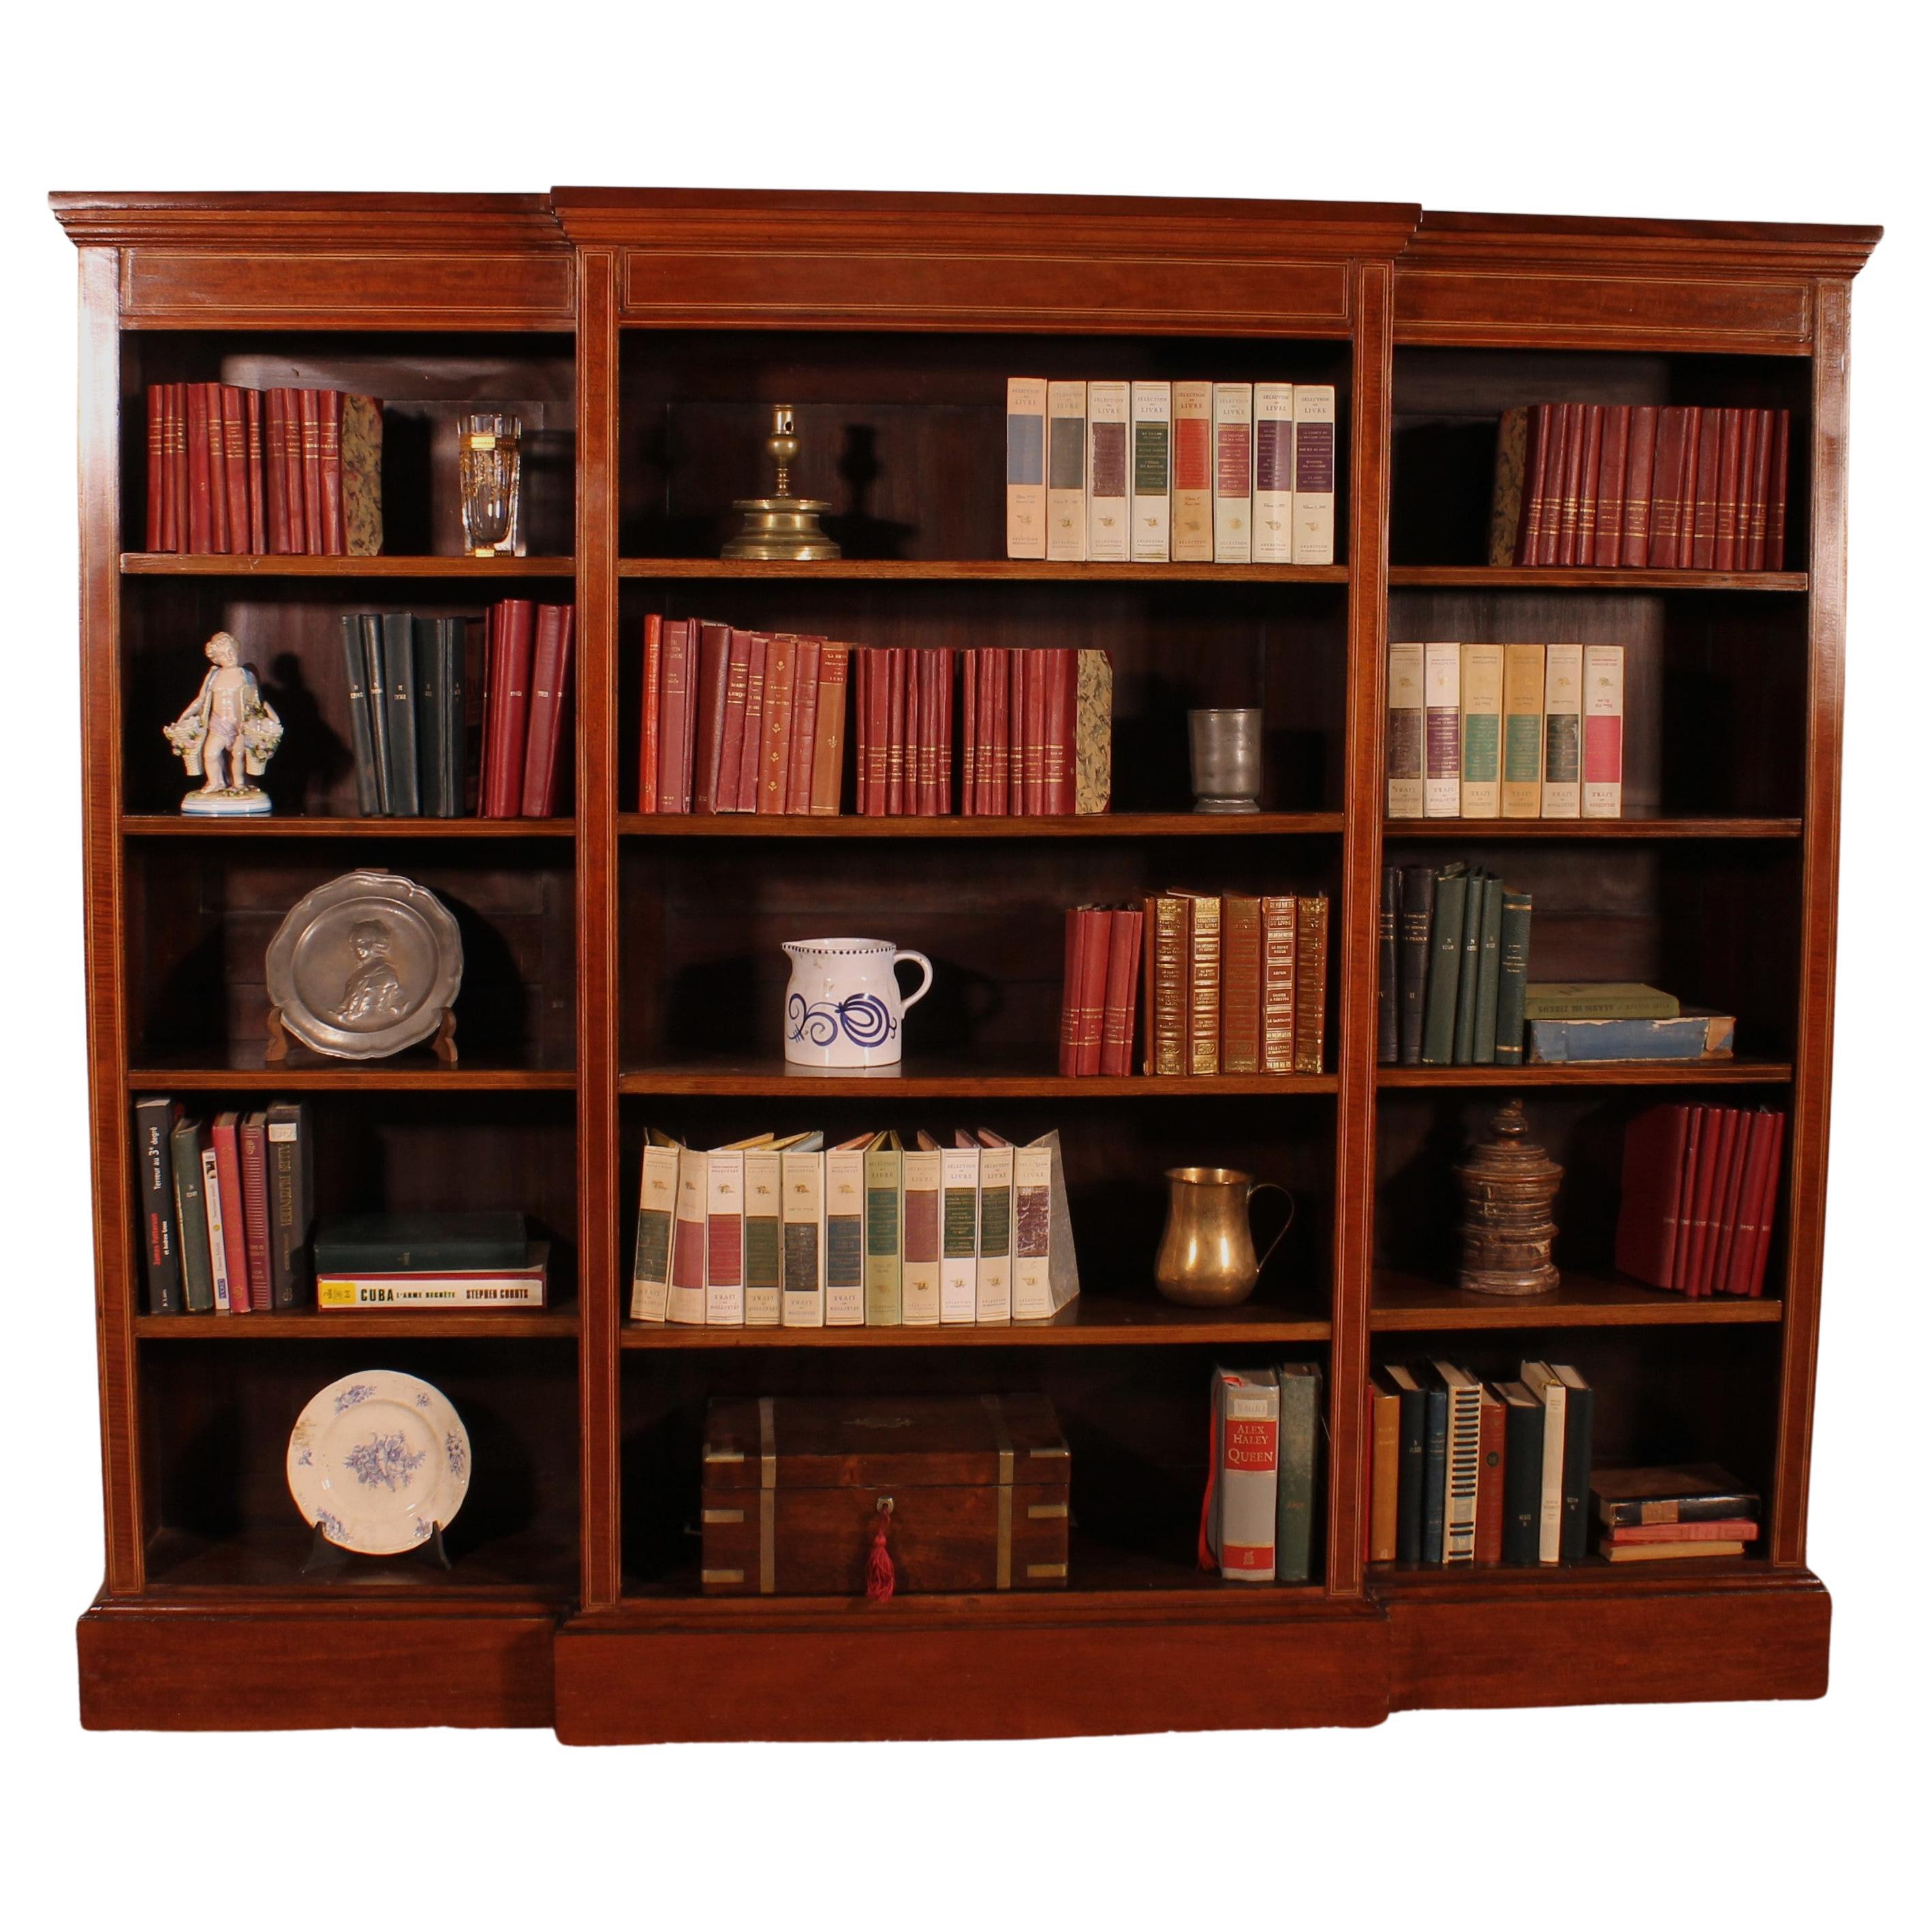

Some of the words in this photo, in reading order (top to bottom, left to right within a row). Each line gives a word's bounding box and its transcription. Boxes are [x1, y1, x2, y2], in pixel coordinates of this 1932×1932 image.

[153, 1157, 160, 1166] au
[153, 1167, 161, 1190] Terreur
[151, 1213, 159, 1244] Patterson
[153, 1245, 161, 1266] James
[360, 1288, 394, 1302] CUBA
[466, 1289, 498, 1299] STEPHEN
[500, 1288, 529, 1299] COONTS
[1237, 1424, 1264, 1435] ALEX
[1233, 1433, 1268, 1445] HALEY
[1228, 1448, 1274, 1465] QUEEN
